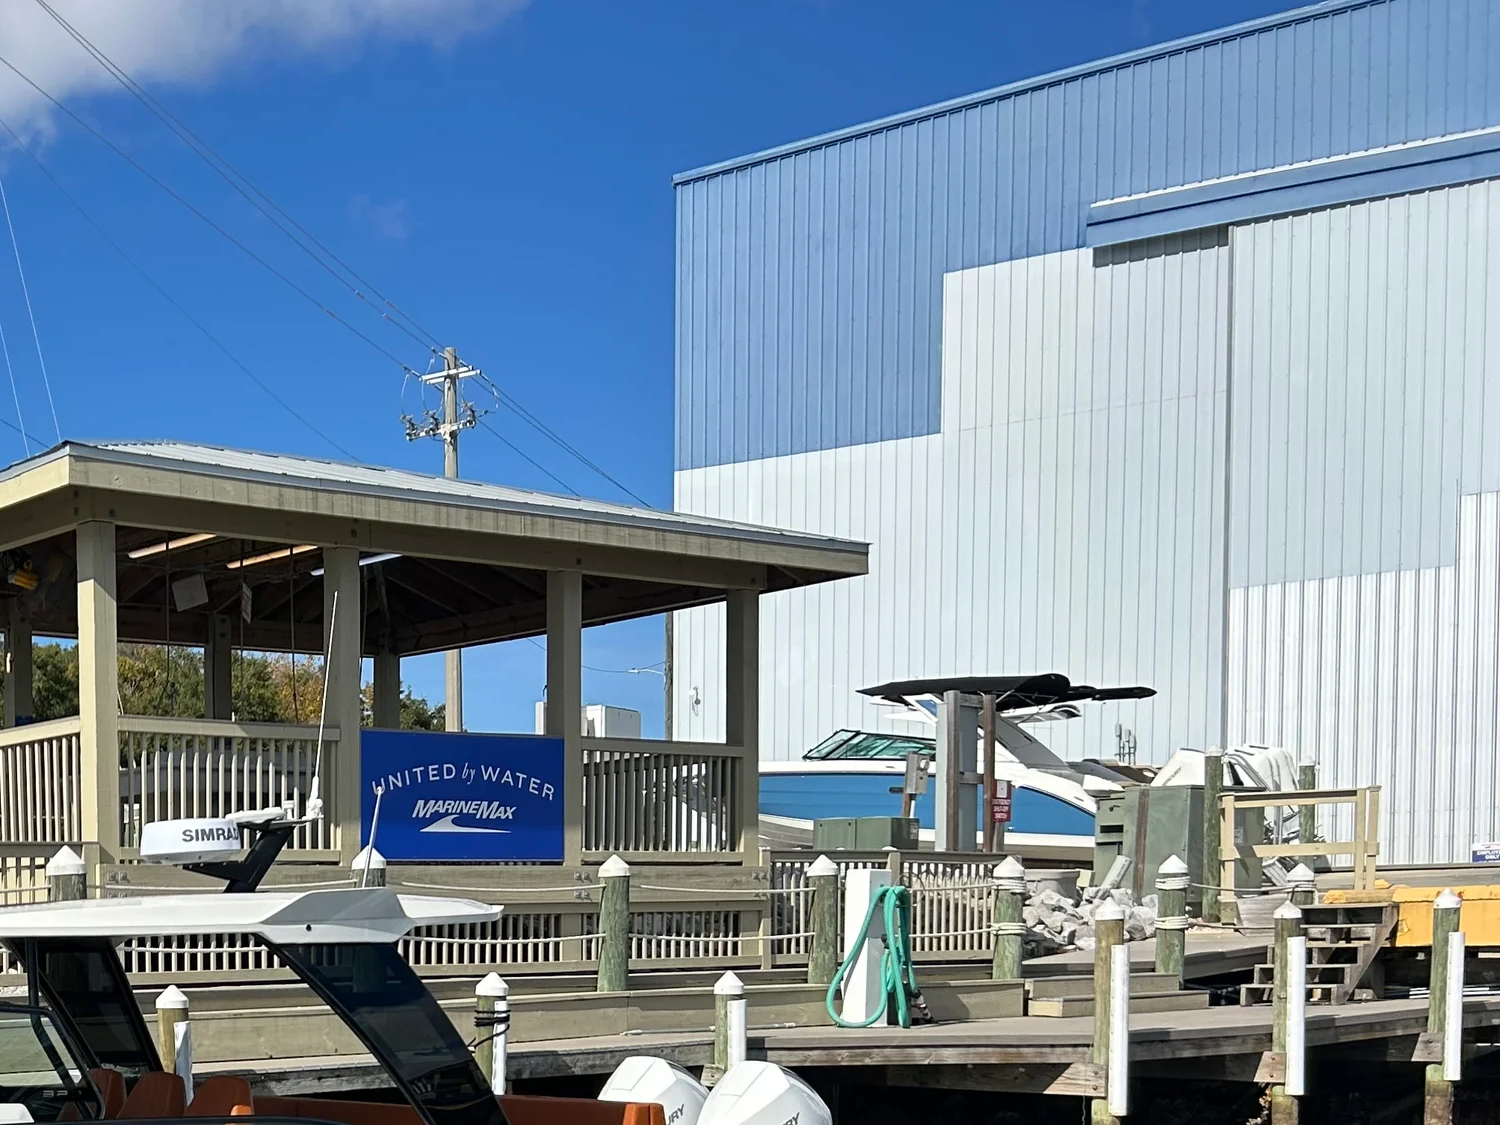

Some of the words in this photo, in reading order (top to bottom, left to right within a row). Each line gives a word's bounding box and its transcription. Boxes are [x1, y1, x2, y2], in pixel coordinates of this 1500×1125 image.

[372, 763, 456, 794] UNITED
[462, 762, 475, 785] by
[481, 764, 555, 801] WATER
